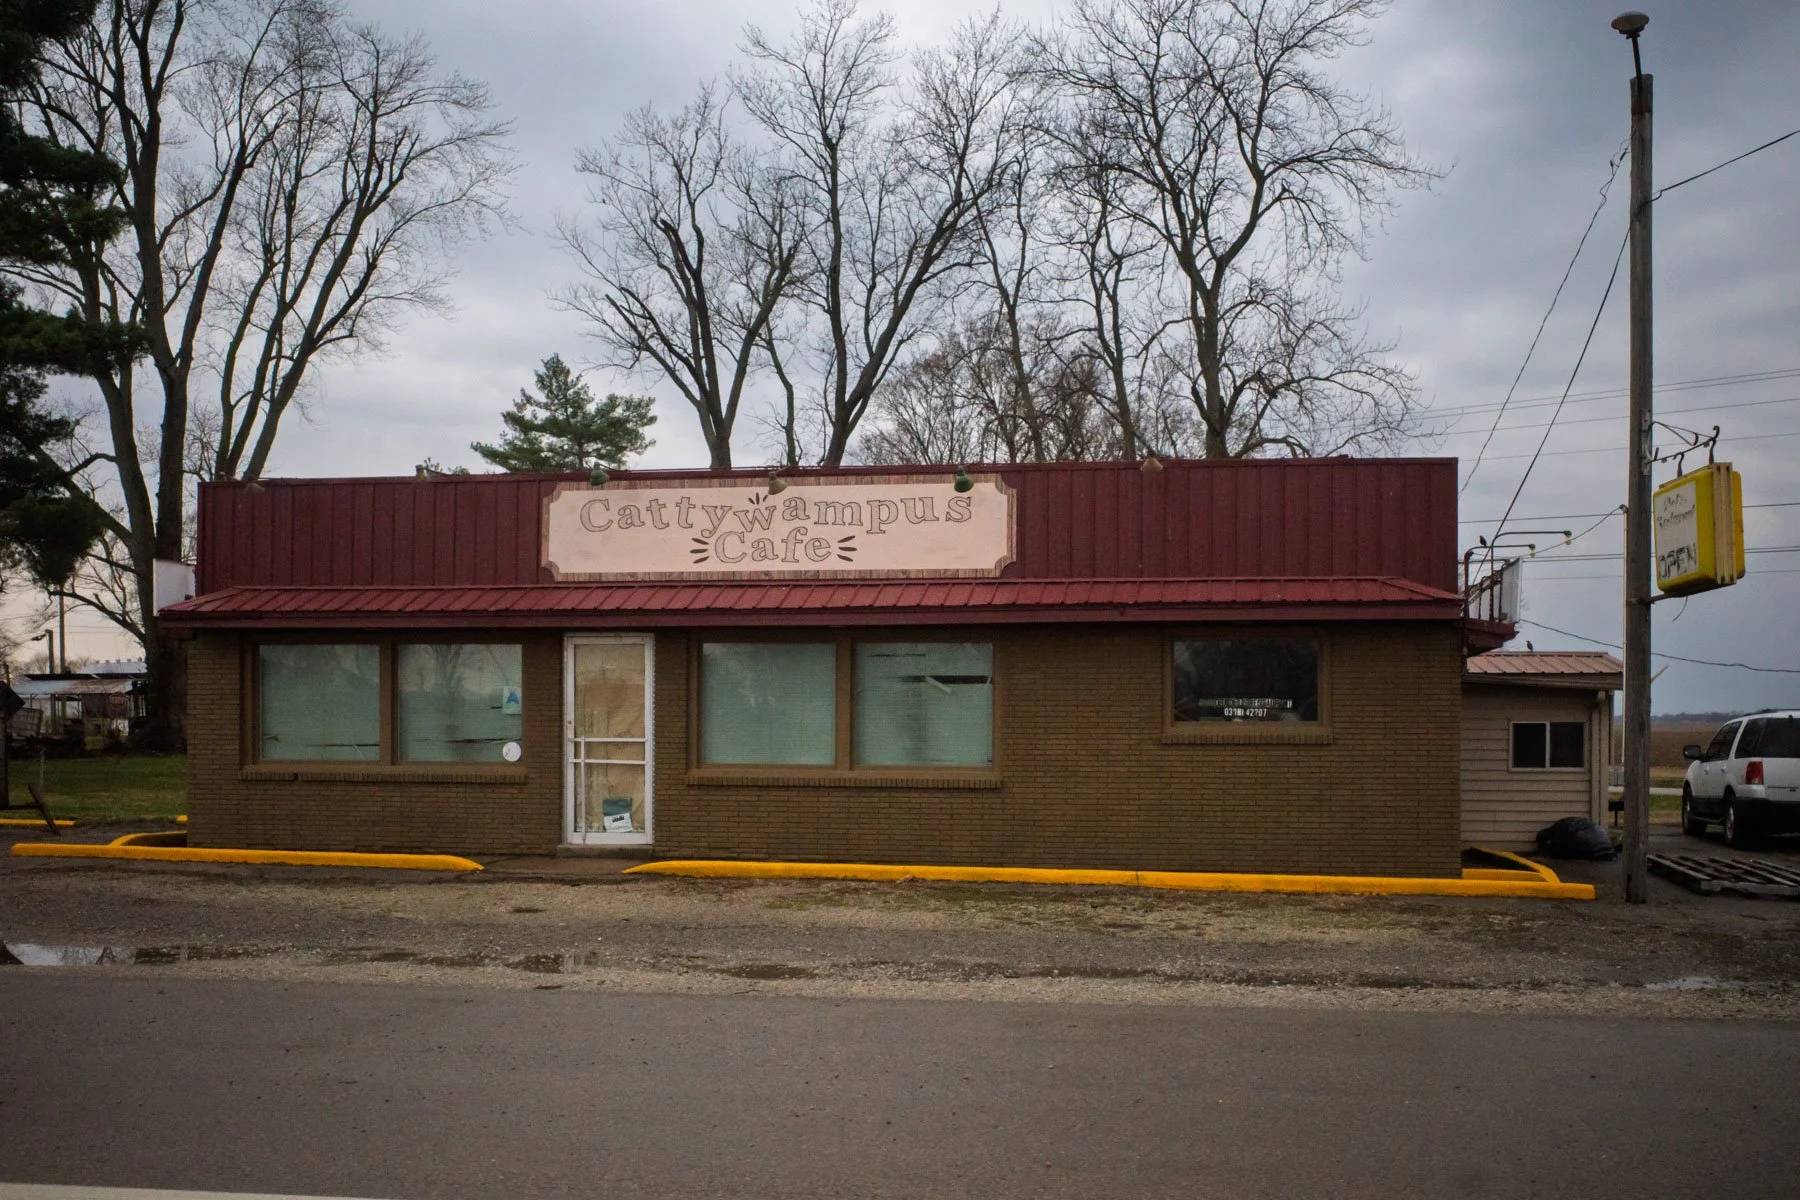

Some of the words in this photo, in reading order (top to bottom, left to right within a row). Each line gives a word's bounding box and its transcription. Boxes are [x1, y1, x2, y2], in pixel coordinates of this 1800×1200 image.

[580, 495, 973, 538] Cattywampus
[713, 526, 832, 564] Cafe
[1658, 542, 1698, 579] OPEN
